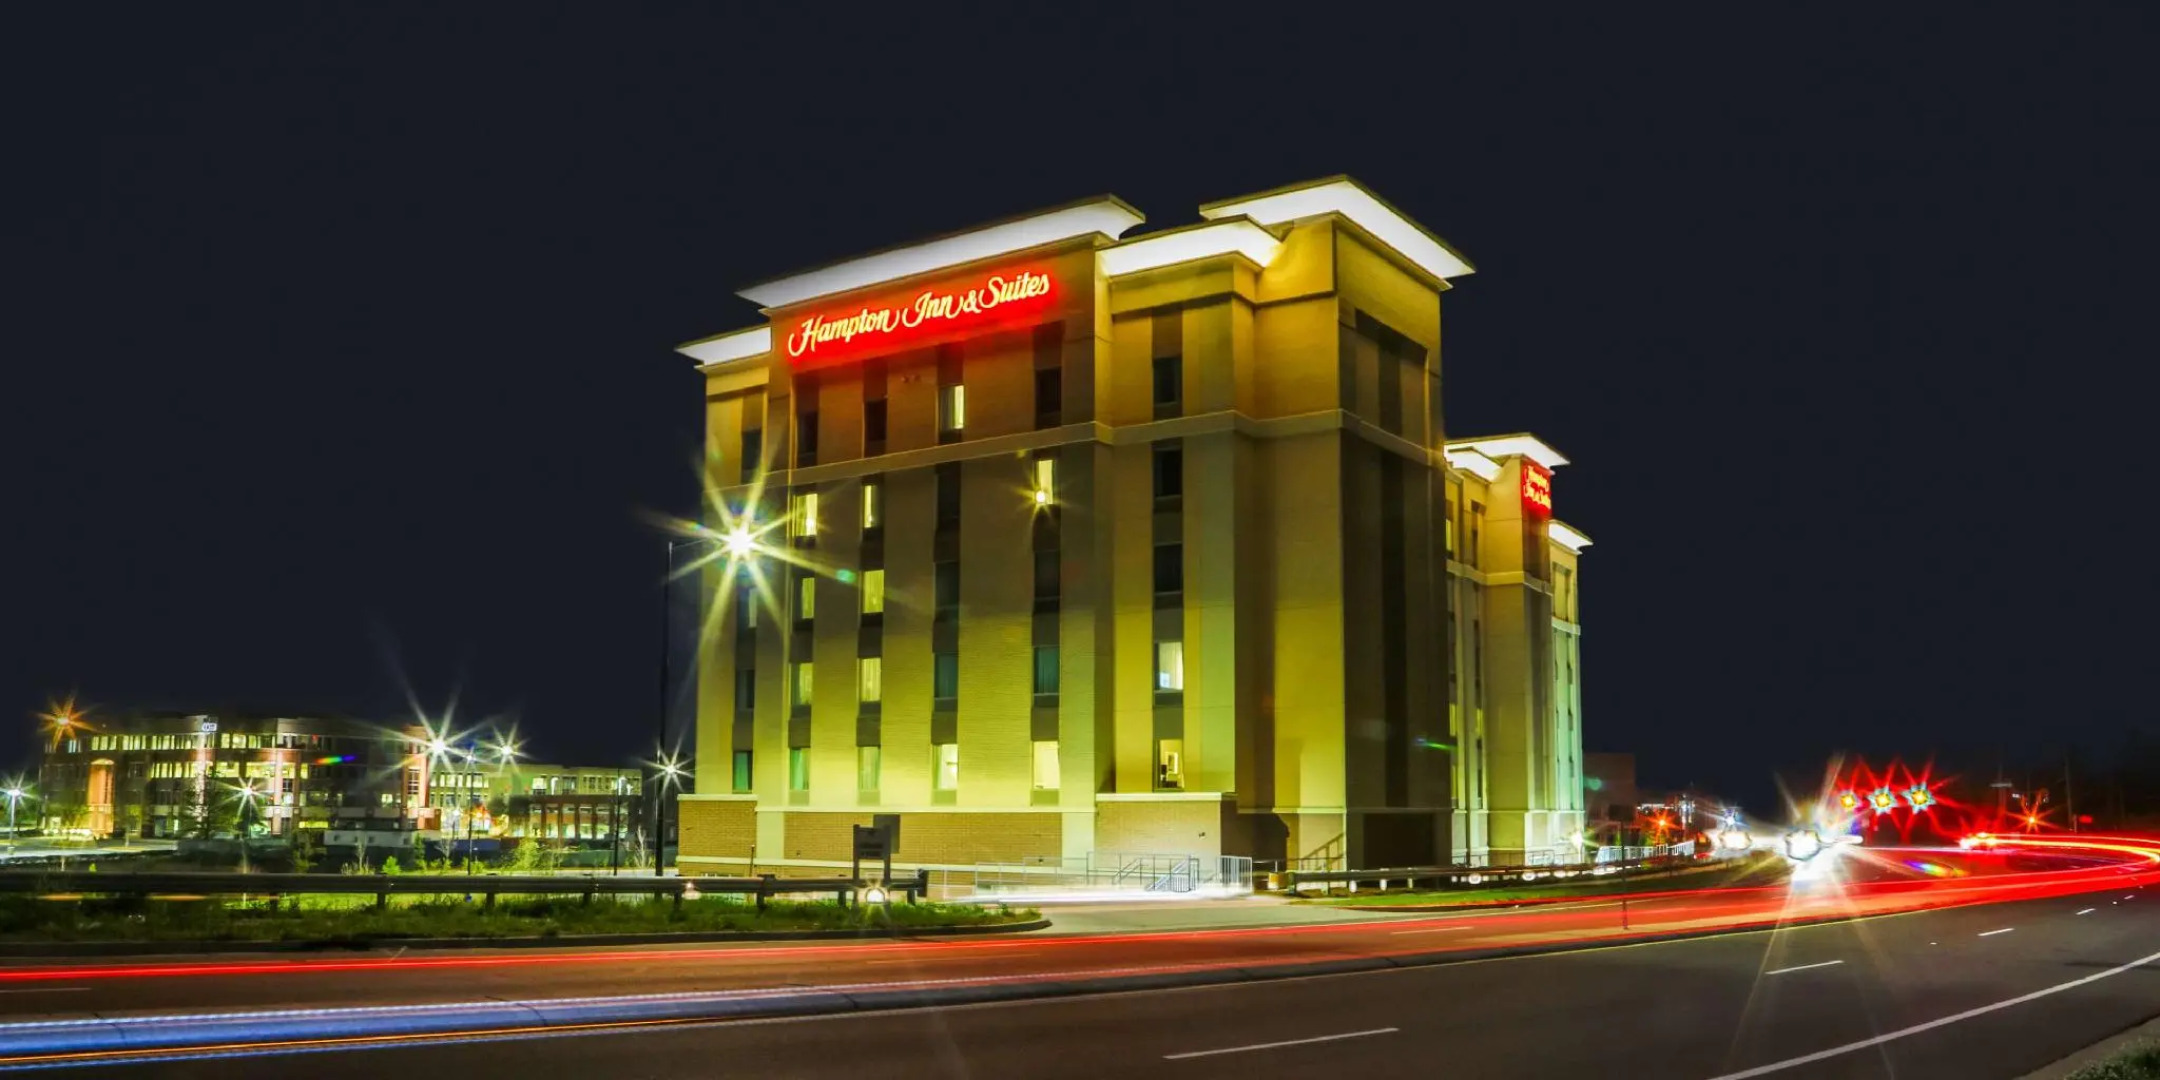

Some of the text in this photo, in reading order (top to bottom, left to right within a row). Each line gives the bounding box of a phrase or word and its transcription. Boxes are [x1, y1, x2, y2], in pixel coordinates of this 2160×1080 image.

[788, 308, 900, 357] Hampton
[902, 291, 964, 327] Inn
[978, 271, 1050, 308] Suites
